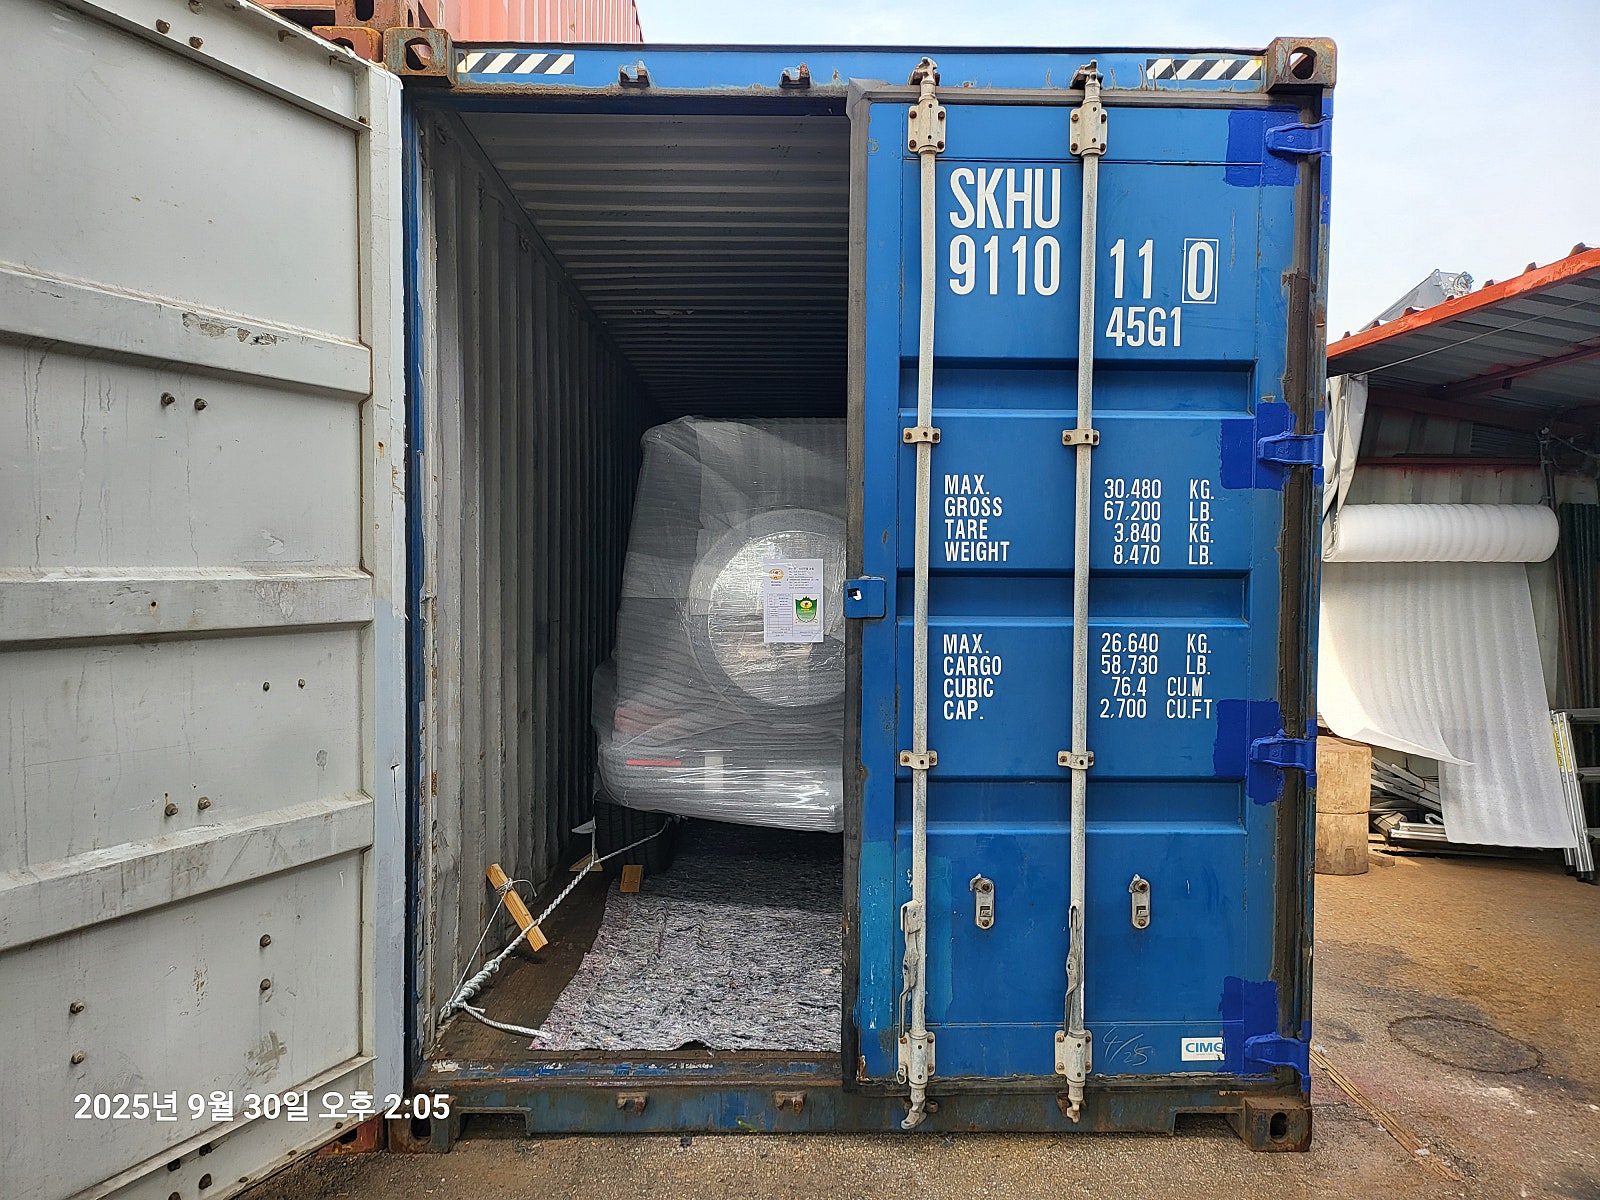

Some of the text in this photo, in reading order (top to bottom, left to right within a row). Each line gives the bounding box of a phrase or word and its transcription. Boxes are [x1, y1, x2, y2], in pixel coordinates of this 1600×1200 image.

[949, 167, 1061, 229] SKHU
[949, 235, 1215, 302] 9110 11 0
[1105, 306, 1182, 347] 45G1
[944, 474, 990, 495] MAX.
[1104, 478, 1215, 500] 30,480 KG.
[944, 497, 1003, 517] GROSS
[1104, 501, 1214, 522] 67,200 LB.
[944, 519, 988, 540] TARE
[1113, 523, 1214, 544] 3,840 KG.
[944, 541, 1010, 562] WEIGHT
[1113, 545, 1214, 565] 8,470 LB.
[943, 634, 990, 655] MAX.
[1101, 633, 1212, 654] 26,640 KG.
[943, 656, 1002, 677] CARGO
[1101, 655, 1211, 676] 58,730 LB.
[943, 678, 994, 699] CUBIC
[1112, 677, 1147, 697] 76.4
[943, 700, 984, 721] CAP.
[1099, 699, 1147, 719] 2,700
